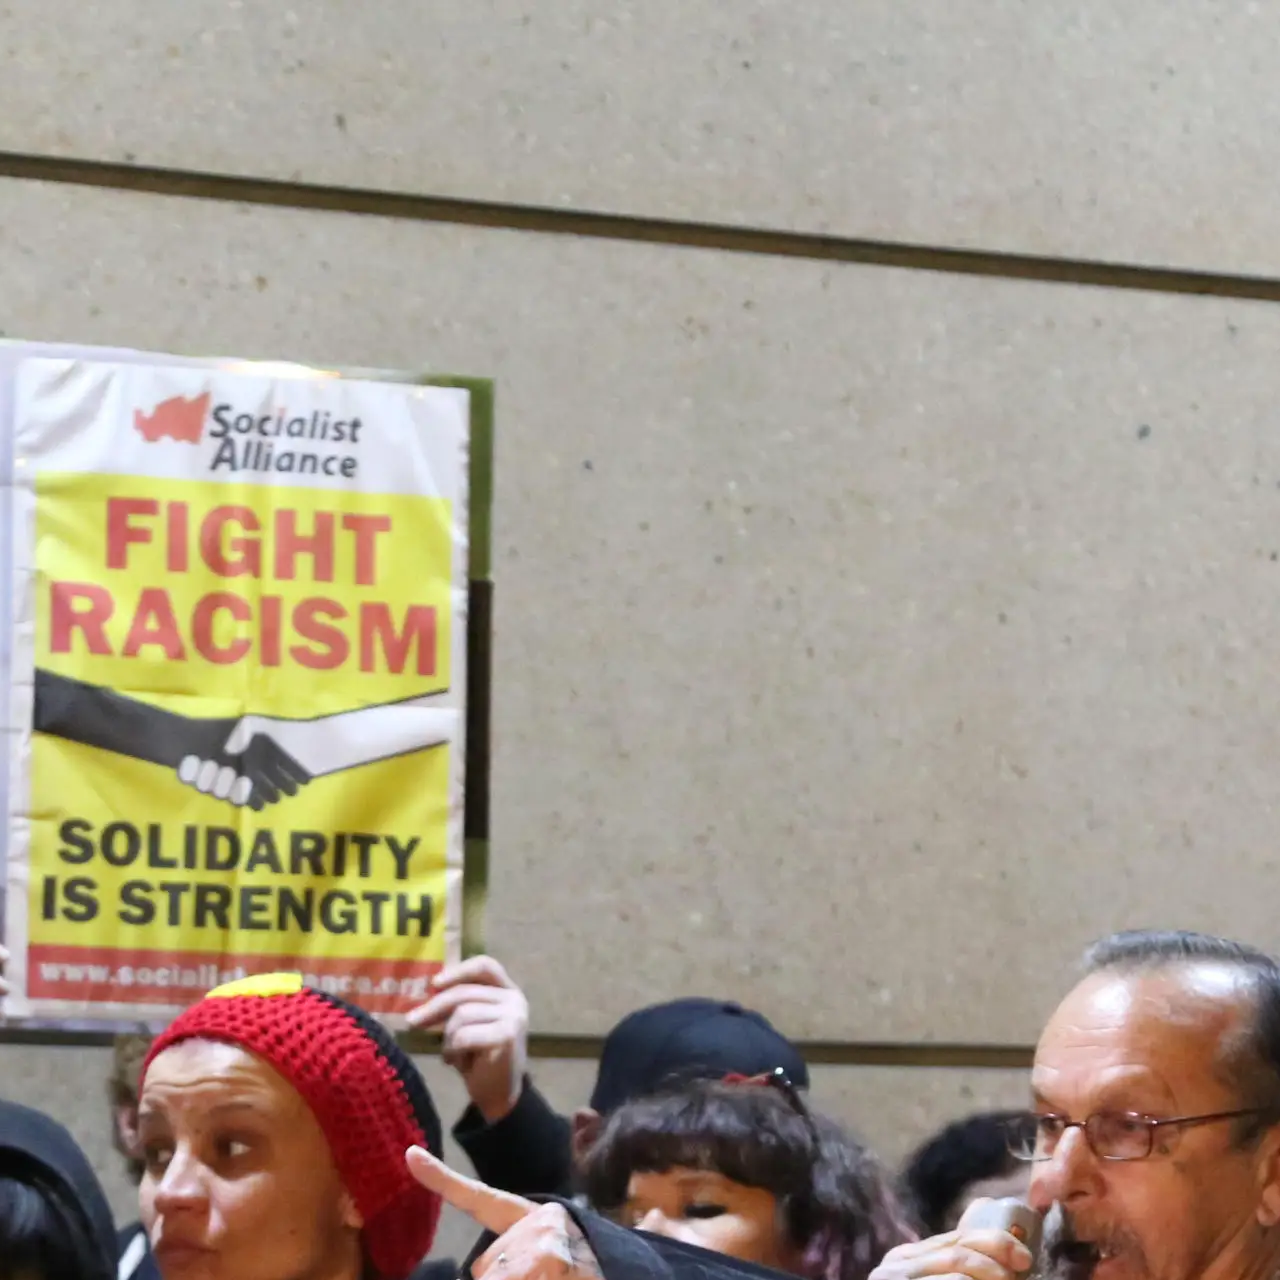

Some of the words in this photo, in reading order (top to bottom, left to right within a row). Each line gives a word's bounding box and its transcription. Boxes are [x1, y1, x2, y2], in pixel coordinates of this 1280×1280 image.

[210, 404, 363, 444] Socialist
[210, 438, 358, 478] Alliance
[106, 496, 391, 586] FIGHT
[48, 580, 437, 676] RACISM
[57, 819, 421, 881] SOLIDARITY
[41, 876, 100, 922] IS
[117, 882, 433, 938] STRENGTH
